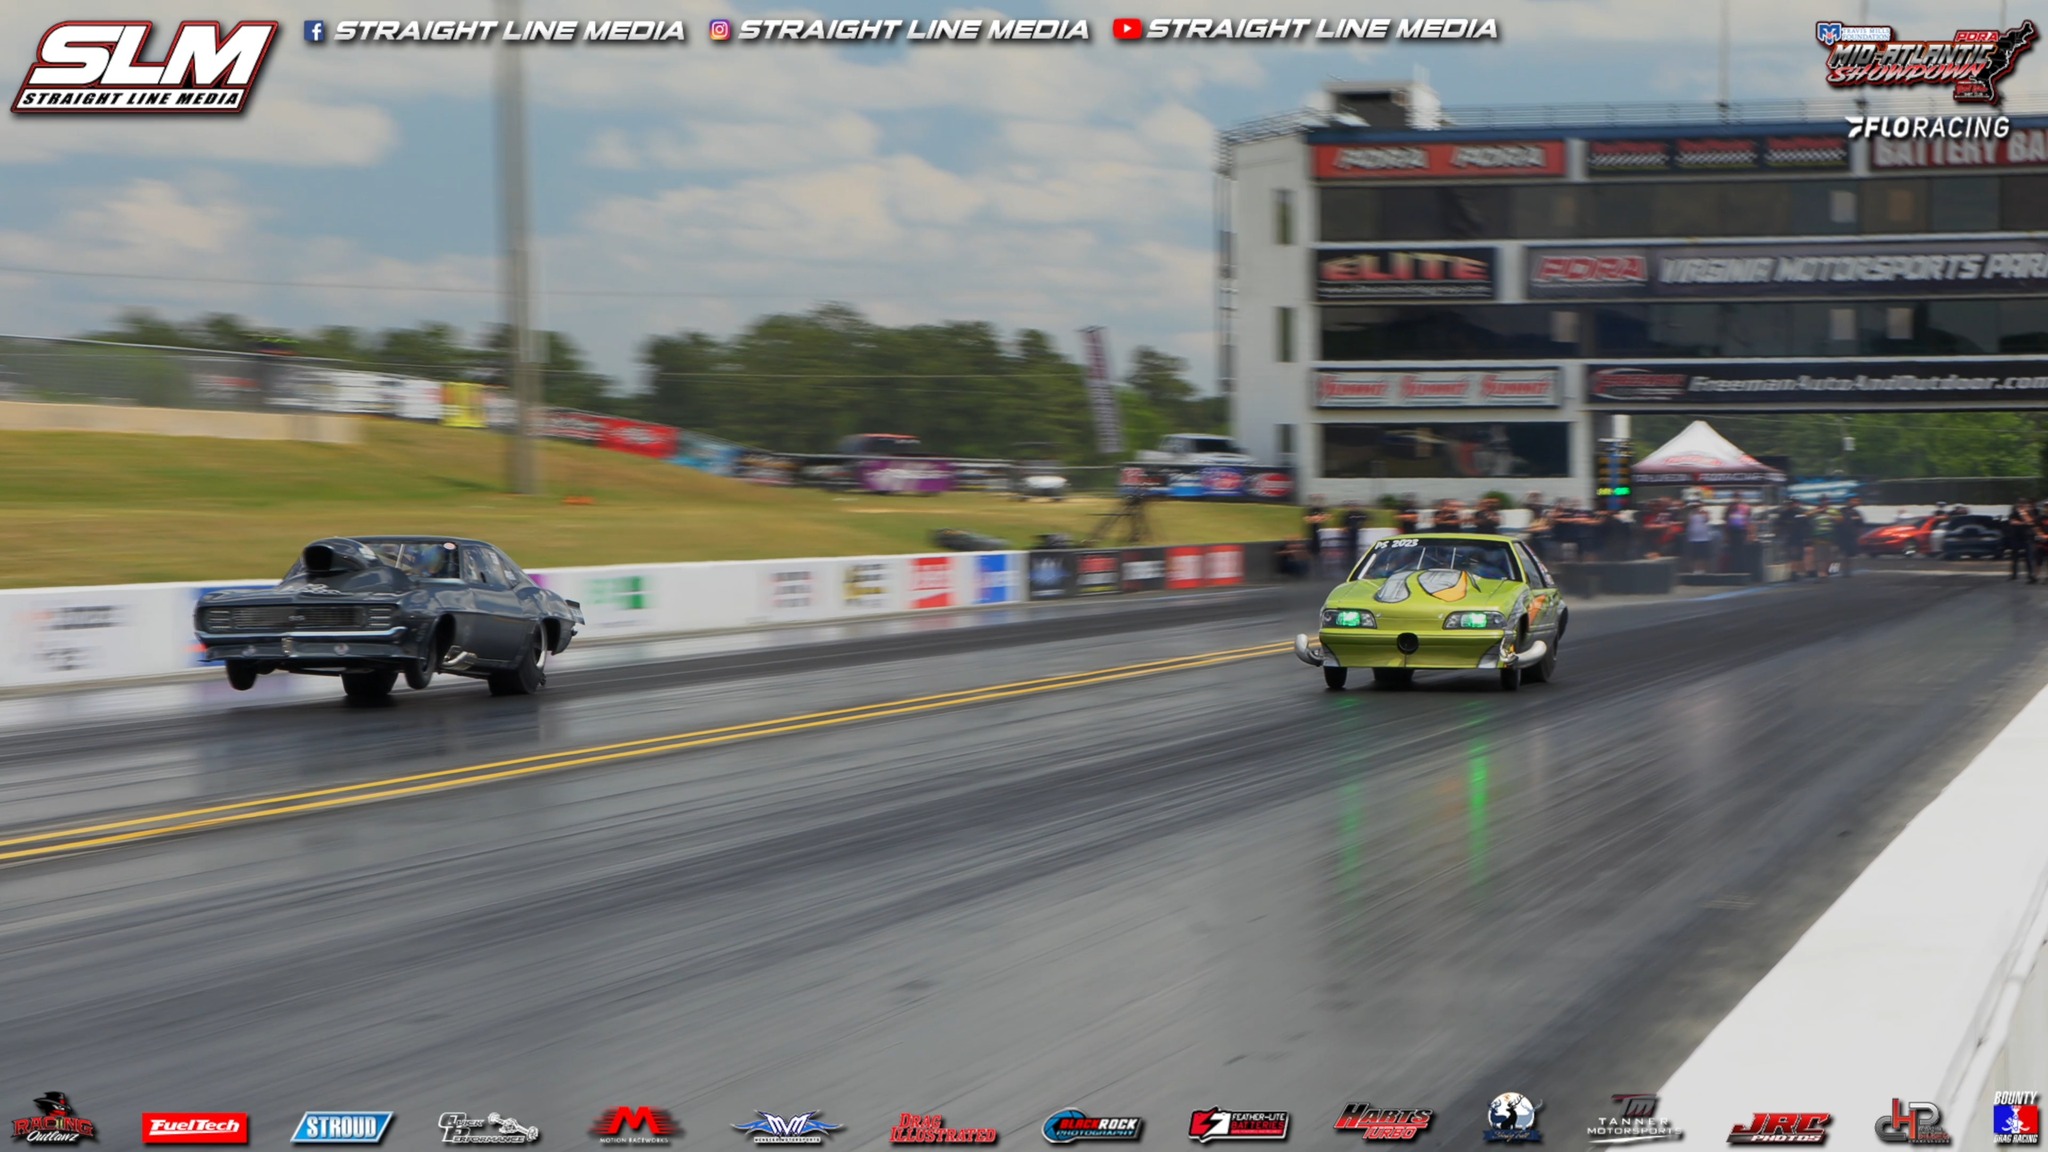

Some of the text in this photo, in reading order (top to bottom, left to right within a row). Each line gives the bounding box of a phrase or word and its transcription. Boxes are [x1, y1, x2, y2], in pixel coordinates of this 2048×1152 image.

[1320, 252, 1489, 281] ELITE
[1533, 256, 1647, 283] PDRA
[1774, 254, 1985, 282] MOTORSPORTS
[1374, 538, 1419, 550] PS 2023
